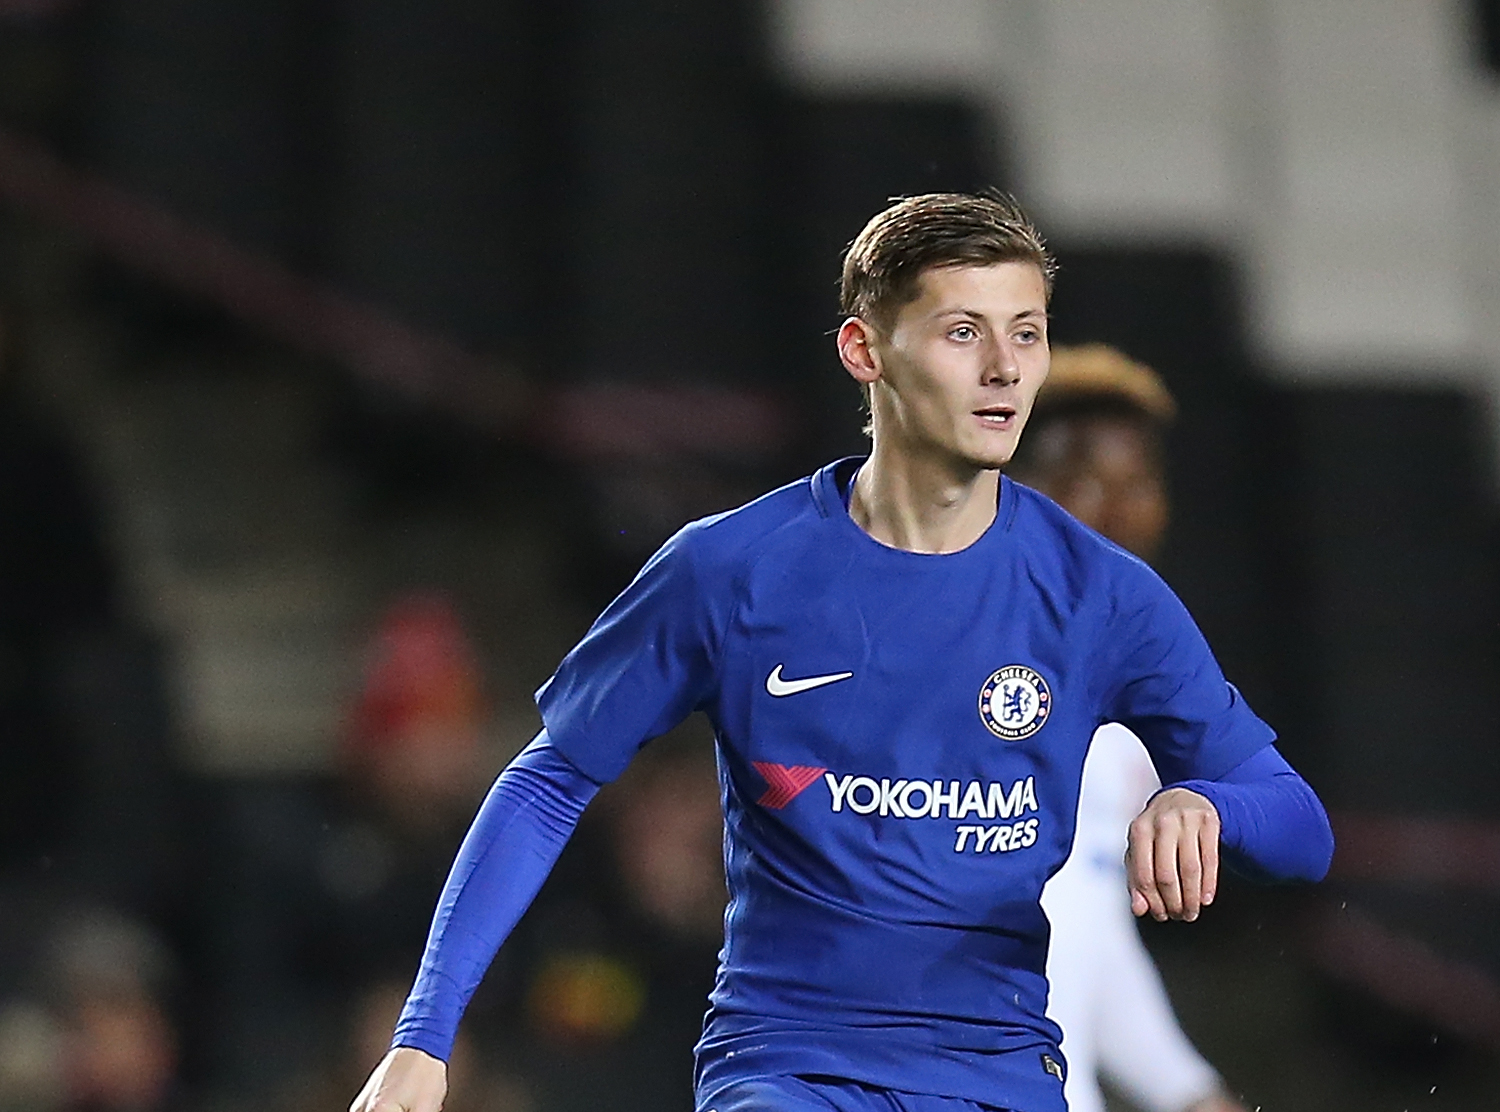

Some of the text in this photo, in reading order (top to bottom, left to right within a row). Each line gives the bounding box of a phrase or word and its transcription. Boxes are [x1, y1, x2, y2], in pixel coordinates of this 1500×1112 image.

[993, 668, 1039, 687] CHELSEA
[825, 773, 1039, 819] YOKOHAMA
[954, 819, 1039, 853] TYRES
